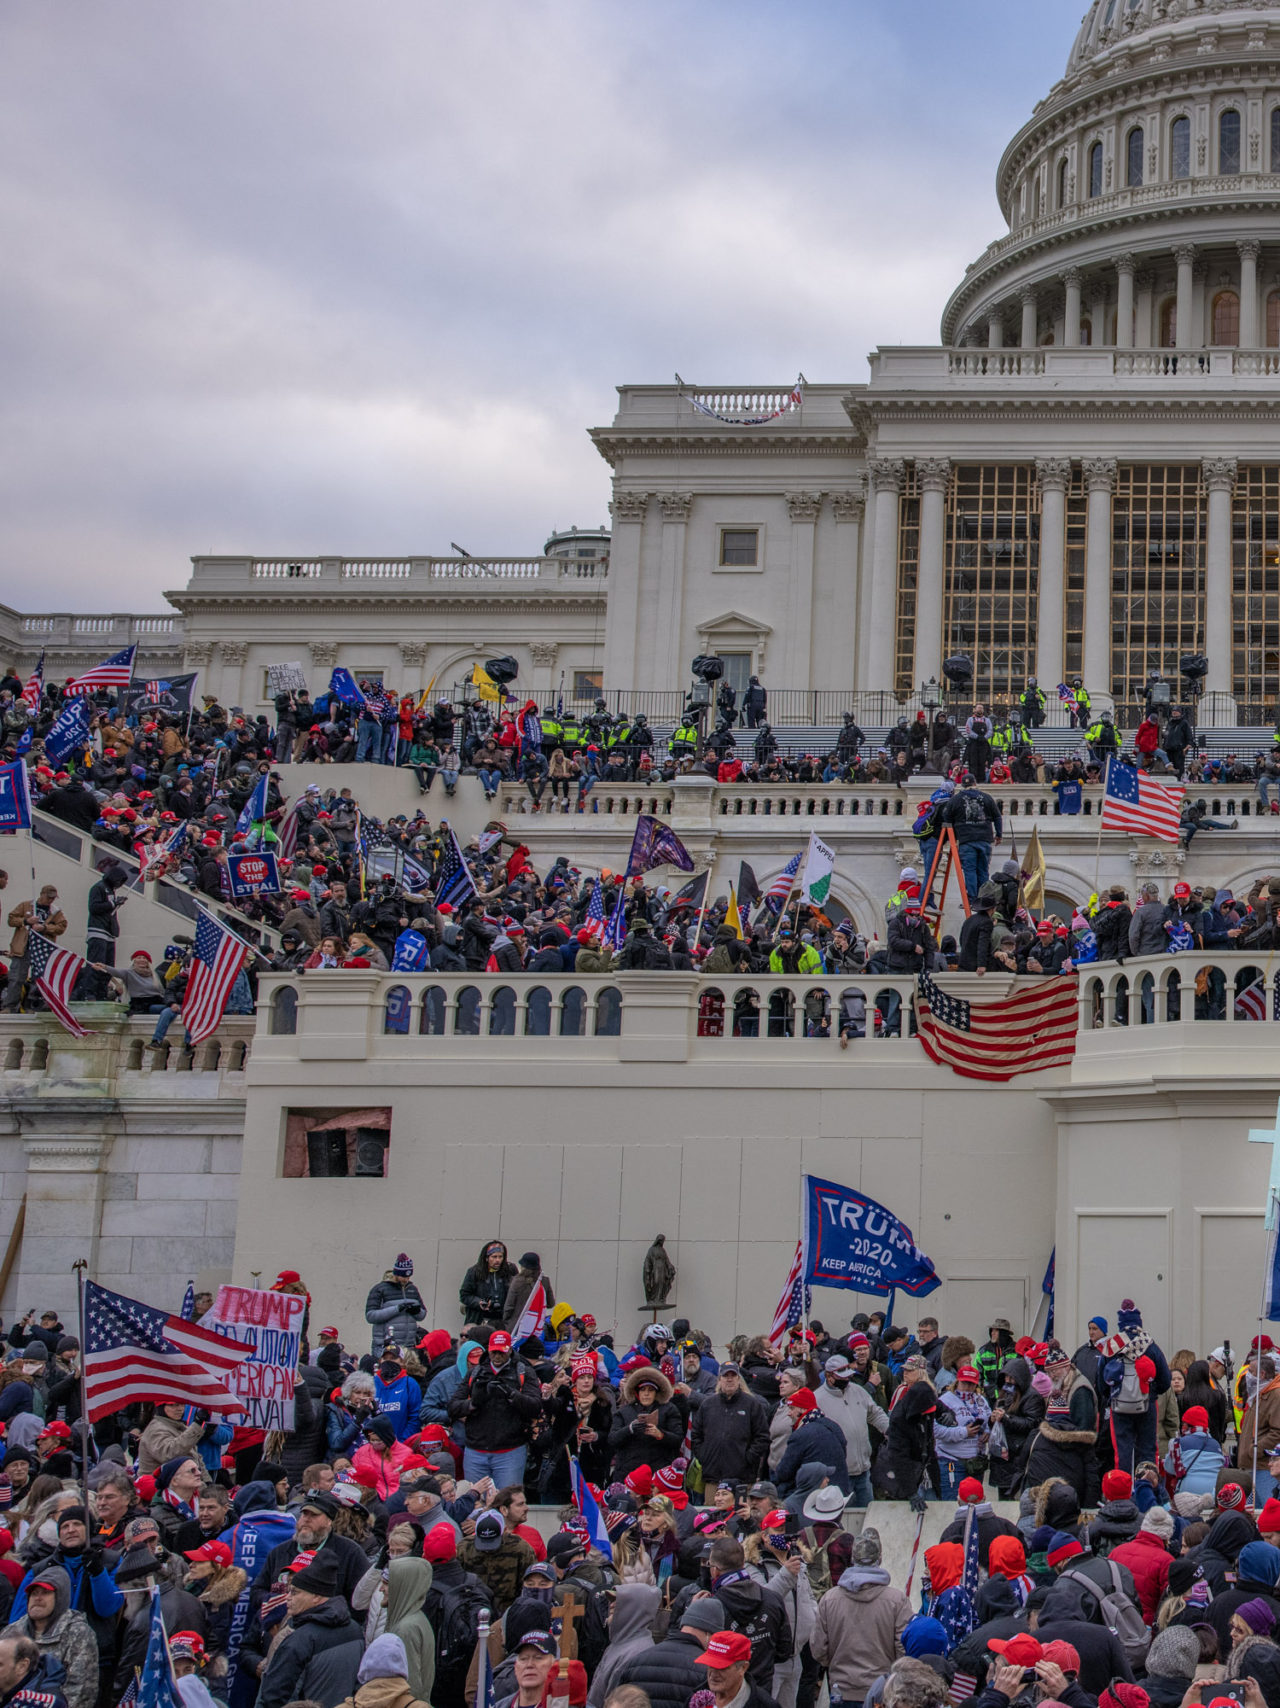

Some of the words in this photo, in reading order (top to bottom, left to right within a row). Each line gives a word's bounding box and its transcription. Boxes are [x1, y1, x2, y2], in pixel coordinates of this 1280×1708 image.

[240, 861, 264, 873] STOP
[236, 882, 276, 893] STEAL
[822, 1258, 846, 1270] KEEP
[220, 1286, 304, 1330] TRUMP
[228, 1576, 252, 1657] AMERICA
